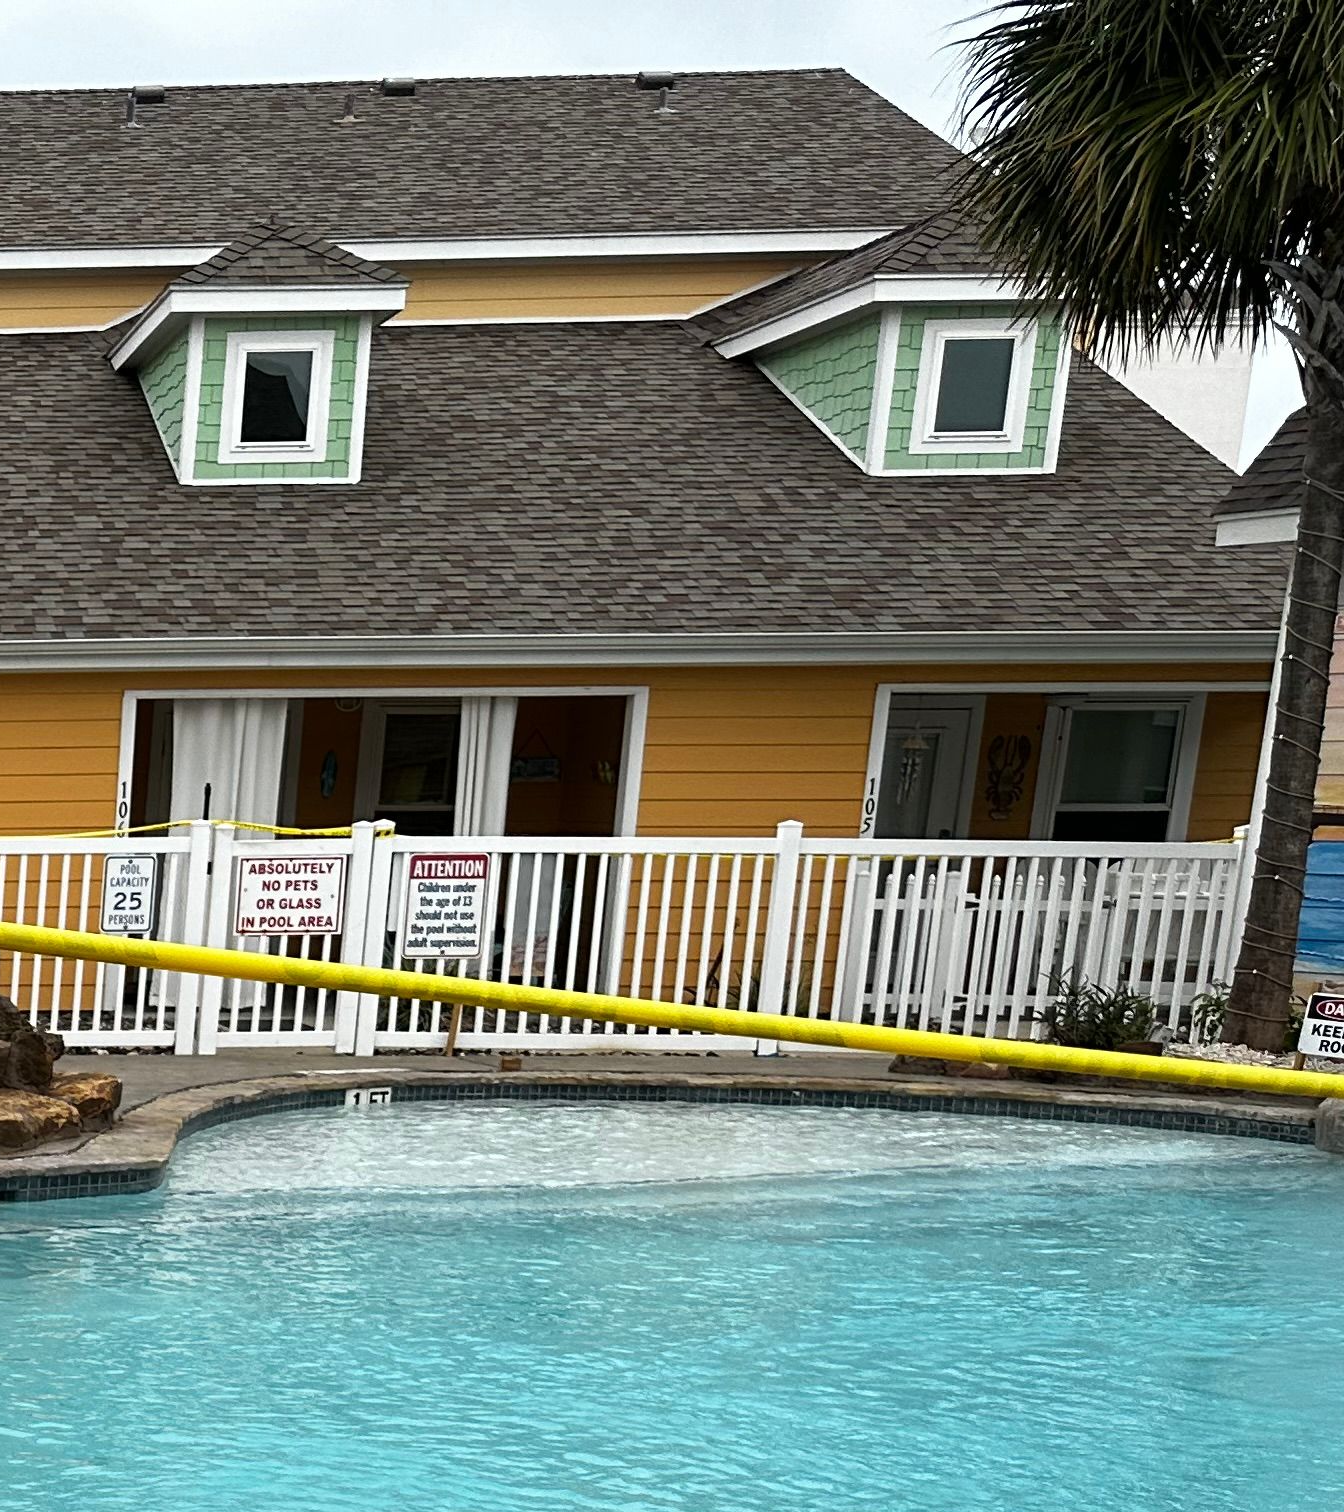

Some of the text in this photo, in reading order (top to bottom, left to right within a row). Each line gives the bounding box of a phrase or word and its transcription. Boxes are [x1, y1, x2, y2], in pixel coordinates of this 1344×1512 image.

[860, 777, 875, 835] 105
[120, 864, 141, 875] POOL
[248, 862, 334, 875] ABSOLUTELY
[413, 859, 484, 877] ATTENTION
[110, 876, 150, 887] CAPACITY
[262, 879, 318, 891] NO PETS
[418, 882, 477, 893] Children under
[113, 892, 142, 910] 25
[256, 897, 321, 910] OR GLASS
[420, 896, 473, 908] the age of 13
[108, 914, 145, 925] PERSONS
[415, 910, 474, 921] should not use
[241, 916, 333, 928] IN POOL AREA
[411, 923, 477, 935] the pool without
[407, 937, 427, 948] adult
[1311, 1024, 1344, 1039] KEE
[353, 1091, 389, 1105] 1 FT
